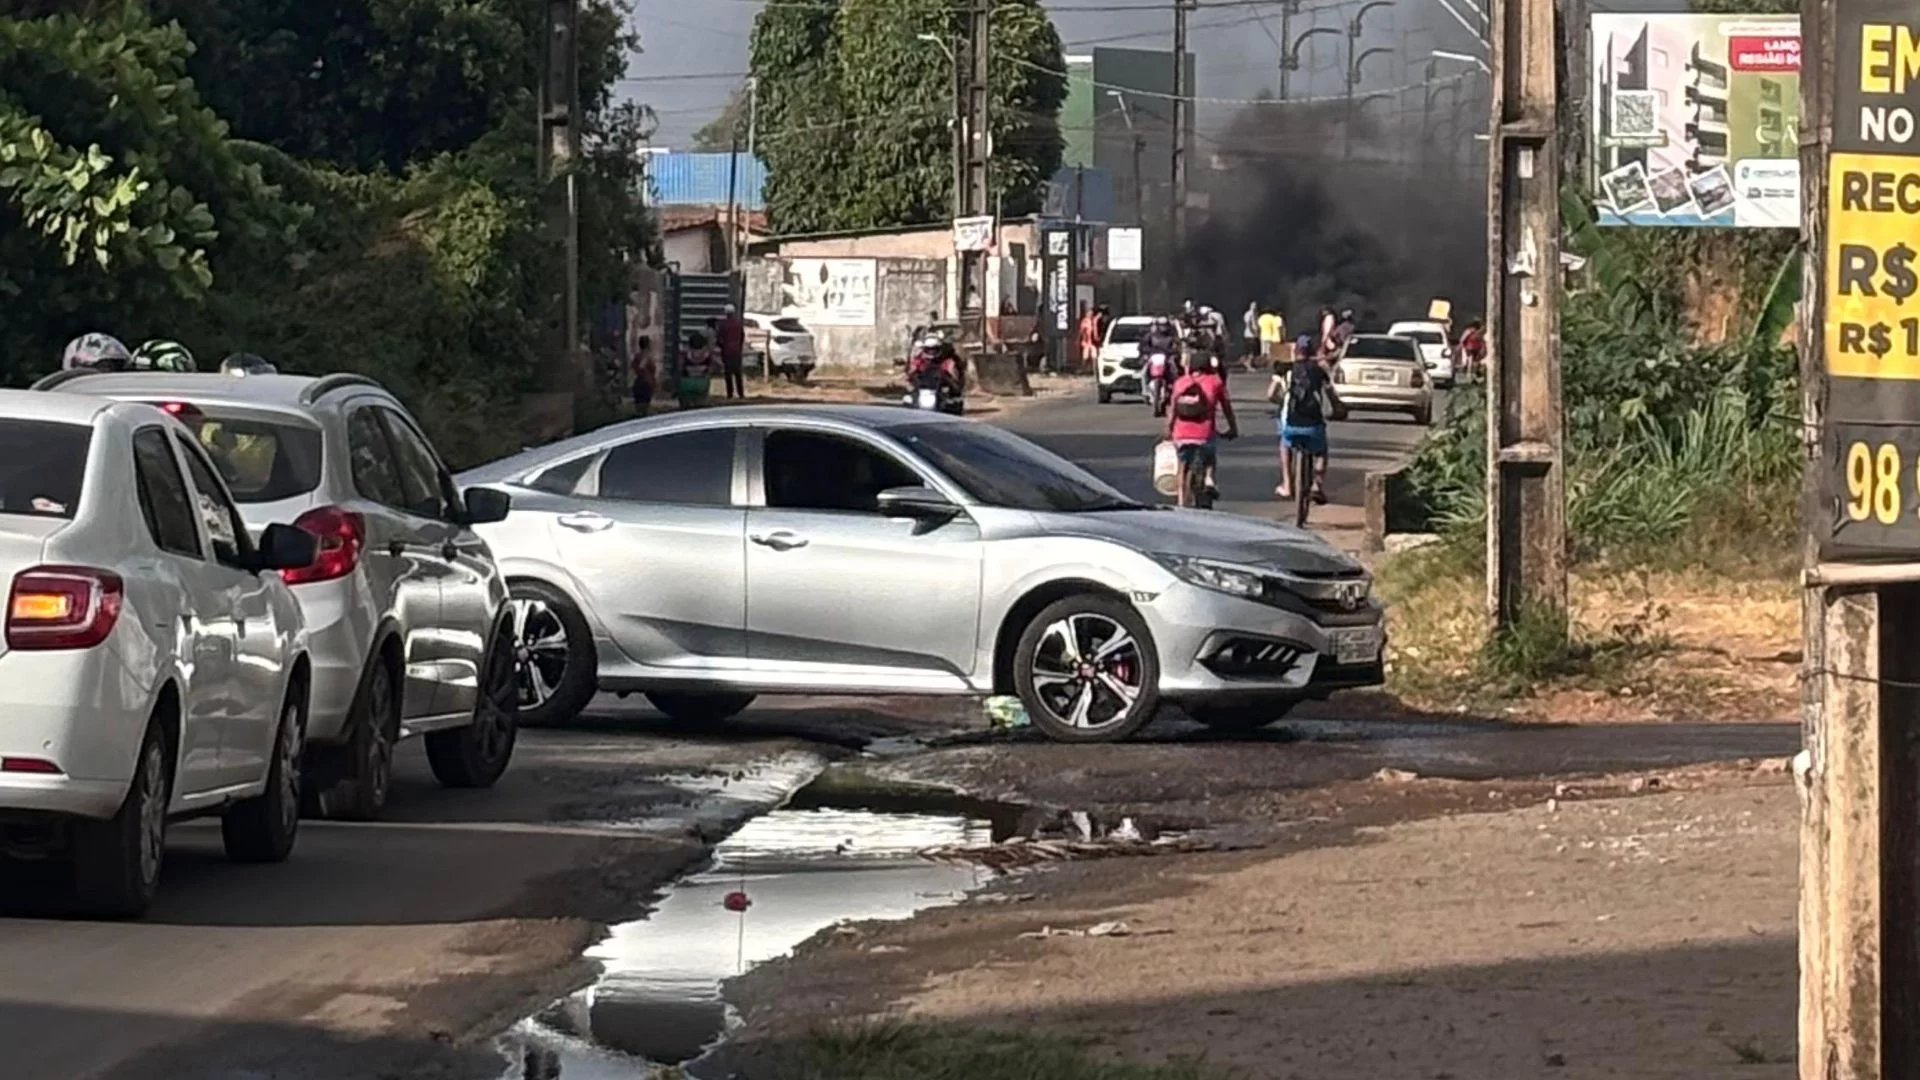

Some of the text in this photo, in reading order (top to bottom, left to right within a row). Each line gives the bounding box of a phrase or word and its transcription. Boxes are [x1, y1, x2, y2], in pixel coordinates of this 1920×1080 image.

[1860, 106, 1914, 143] NO
[1838, 242, 1918, 306] R$
[1839, 321, 1892, 359] R$
[1846, 441, 1901, 524] 98
